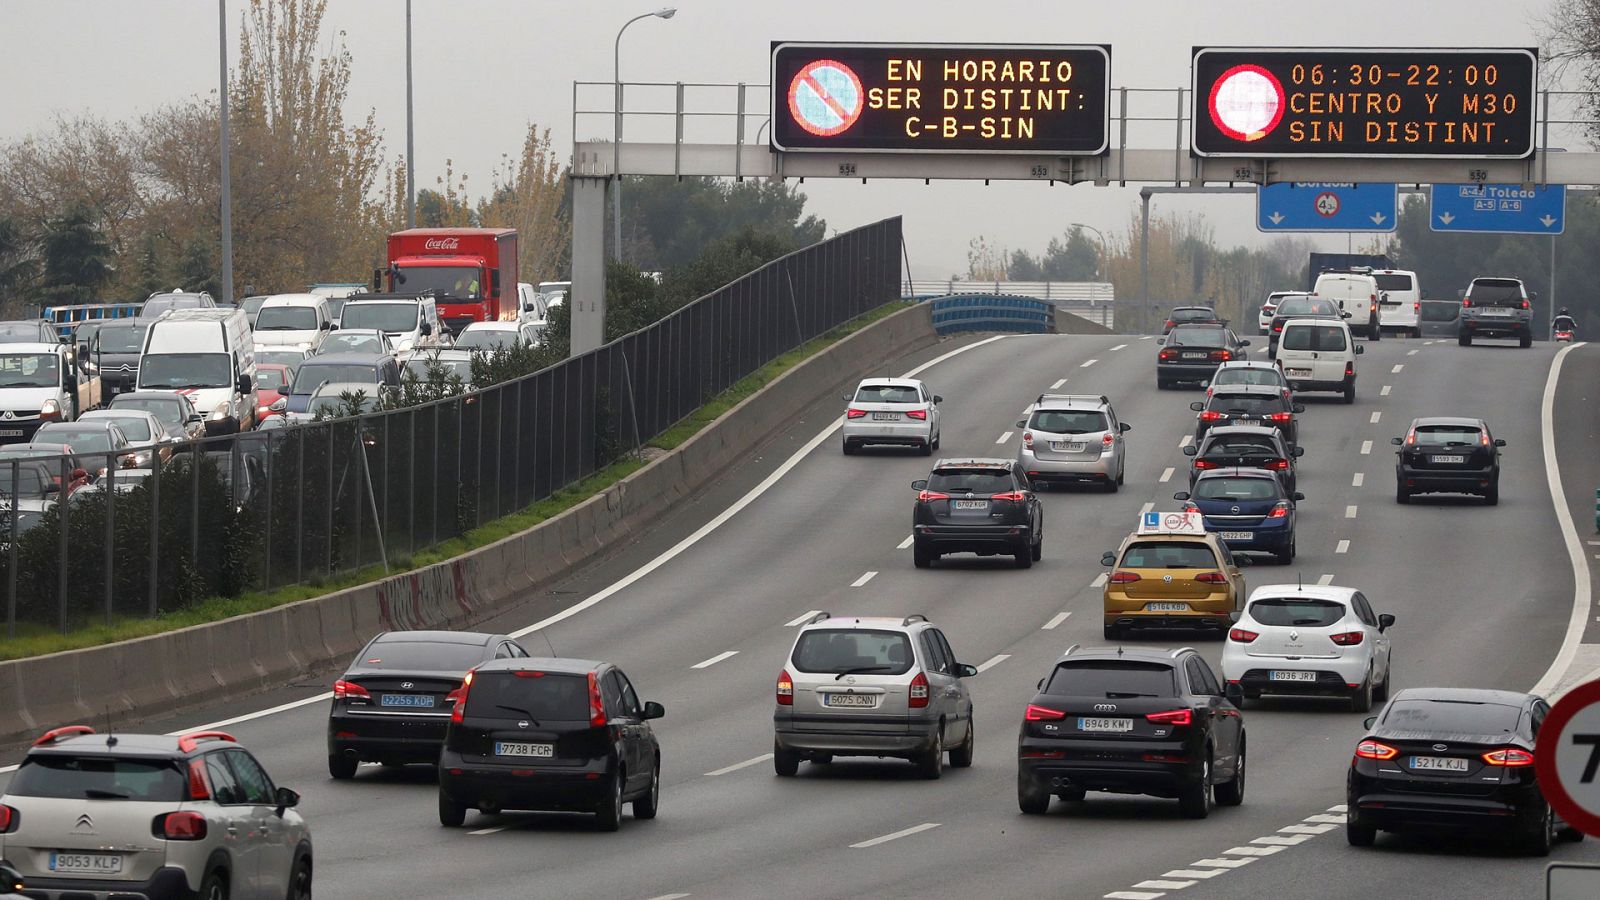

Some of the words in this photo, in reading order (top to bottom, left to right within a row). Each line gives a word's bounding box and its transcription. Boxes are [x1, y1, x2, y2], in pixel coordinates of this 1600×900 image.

[887, 60, 922, 82] EN
[943, 61, 1072, 82] HORARIO
[868, 88, 921, 110] SER
[943, 88, 1084, 111] DISTINT:
[1290, 92, 1402, 114] CENTRO
[1425, 93, 1438, 114] Y
[1463, 93, 1517, 115] M30
[905, 117, 1034, 139] C-B-SIN
[1289, 121, 1344, 142] SIN
[1366, 121, 1511, 143] DISTINT.
[1489, 187, 1536, 199] Toledo
[1148, 514, 1156, 525] L
[1275, 671, 1297, 680] 6036
[1299, 672, 1316, 681] JRX
[389, 696, 412, 705] 2256
[831, 695, 854, 704] 6075
[856, 695, 873, 705] CNN
[1085, 719, 1110, 728] 6948
[1112, 720, 1131, 729] KMY
[503, 744, 528, 755] 7738
[530, 745, 550, 756] FCR
[1416, 758, 1442, 768] 5214
[1446, 759, 1466, 770] KJL
[58, 855, 91, 868] 9053
[94, 856, 120, 869] KLP
